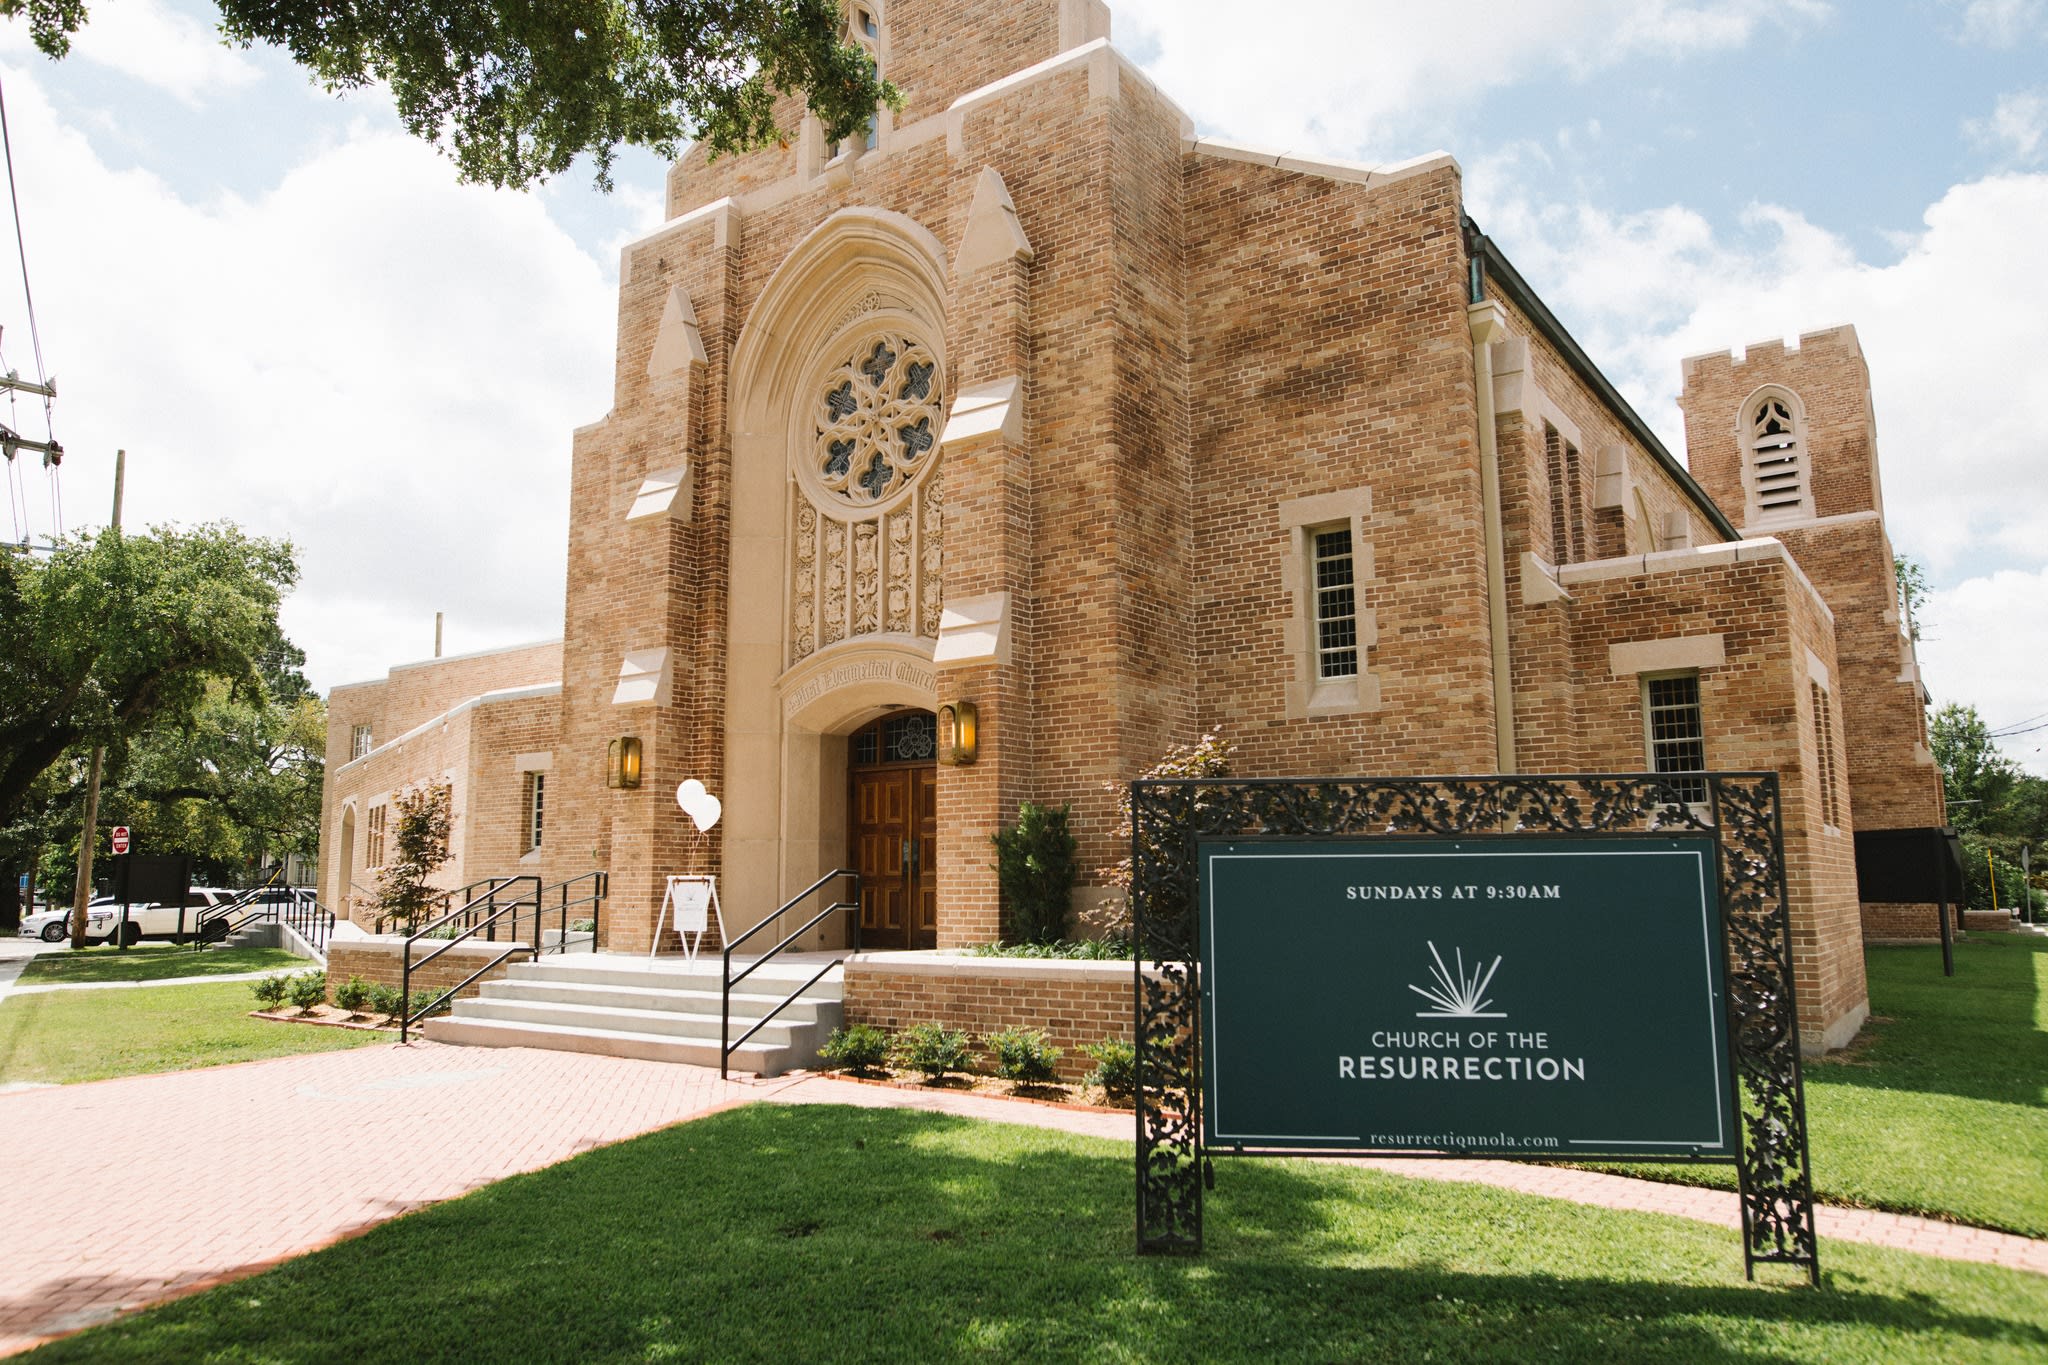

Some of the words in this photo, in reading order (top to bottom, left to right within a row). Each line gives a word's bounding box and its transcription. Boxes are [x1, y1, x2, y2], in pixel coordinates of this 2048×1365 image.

[1346, 885, 1443, 900] SUNDAYS
[1451, 885, 1478, 899] AT
[1486, 884, 1561, 899] 9:30AM
[1371, 1031, 1460, 1049] CHURCH
[1468, 1031, 1498, 1049] OF
[1506, 1032, 1549, 1049] THE
[1339, 1055, 1585, 1081] RESURRECTION
